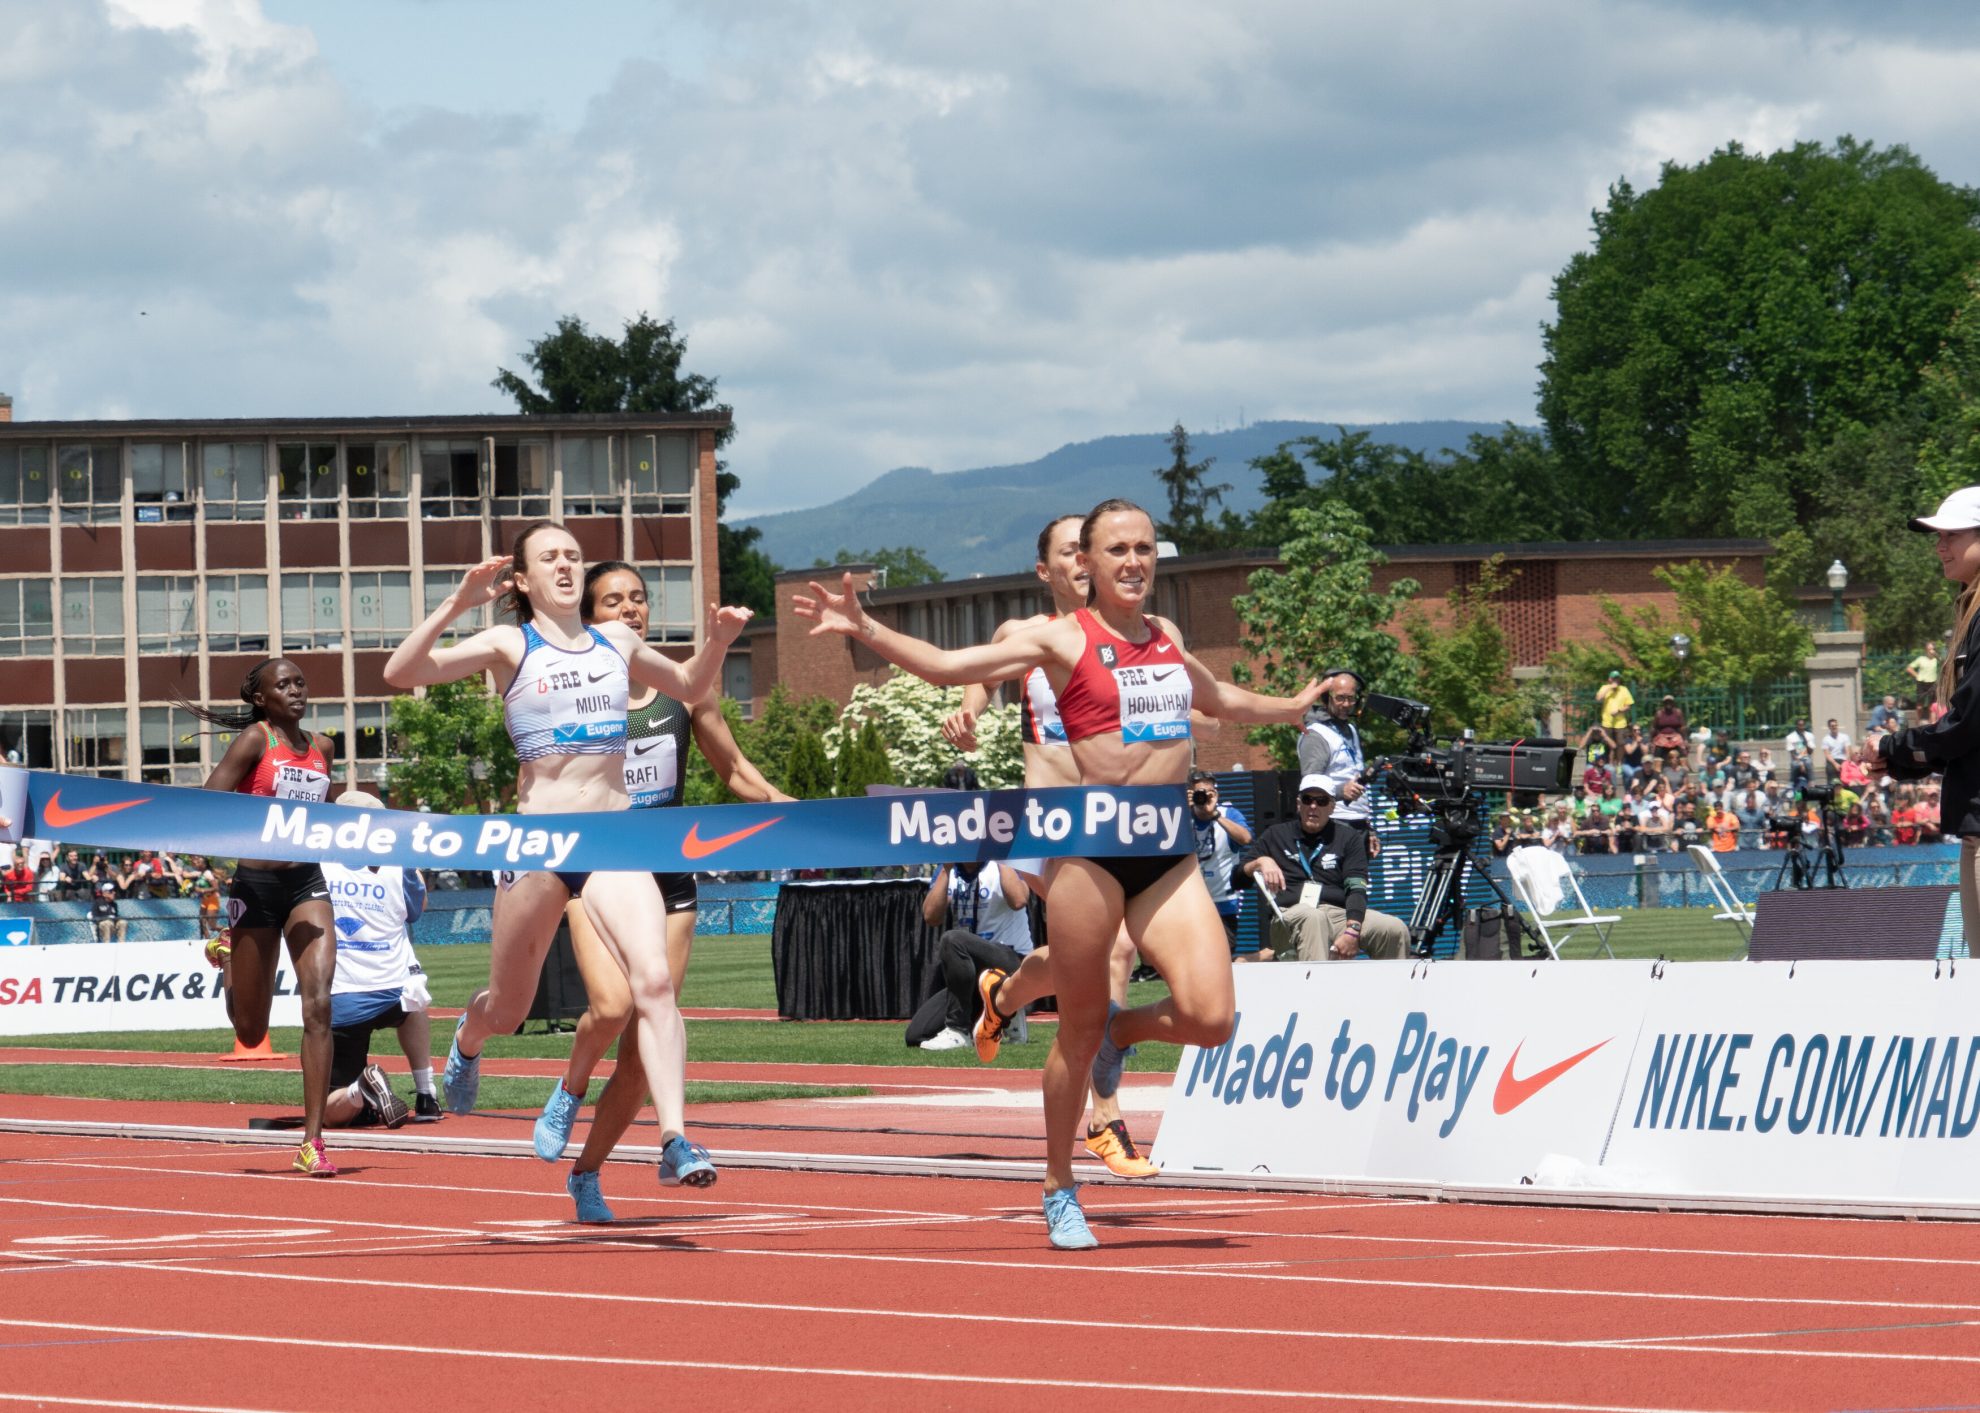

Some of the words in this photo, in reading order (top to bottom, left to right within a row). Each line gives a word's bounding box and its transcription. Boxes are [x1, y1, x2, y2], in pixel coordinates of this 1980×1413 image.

[549, 670, 582, 691] PRE
[1118, 668, 1148, 687] PRE
[575, 694, 611, 715] MUIR
[1127, 693, 1188, 716] HOULIHAN
[585, 722, 624, 737] Eugene
[1153, 722, 1188, 737] Eugene
[283, 767, 303, 782] PRE
[625, 765, 658, 786] RAFI
[630, 790, 669, 805] Eugene
[890, 796, 1014, 846] Made
[1025, 797, 1072, 841] to
[1084, 791, 1183, 850] Play
[260, 803, 397, 854] Made
[411, 821, 463, 857] to
[475, 820, 580, 869] Play
[330, 881, 386, 899] HOTO
[0, 977, 43, 1006] SA
[52, 972, 181, 1004] TRACK
[182, 971, 206, 999] &
[1184, 1011, 1313, 1109] Made
[1324, 1019, 1376, 1111] to
[1384, 1011, 1490, 1139] Play
